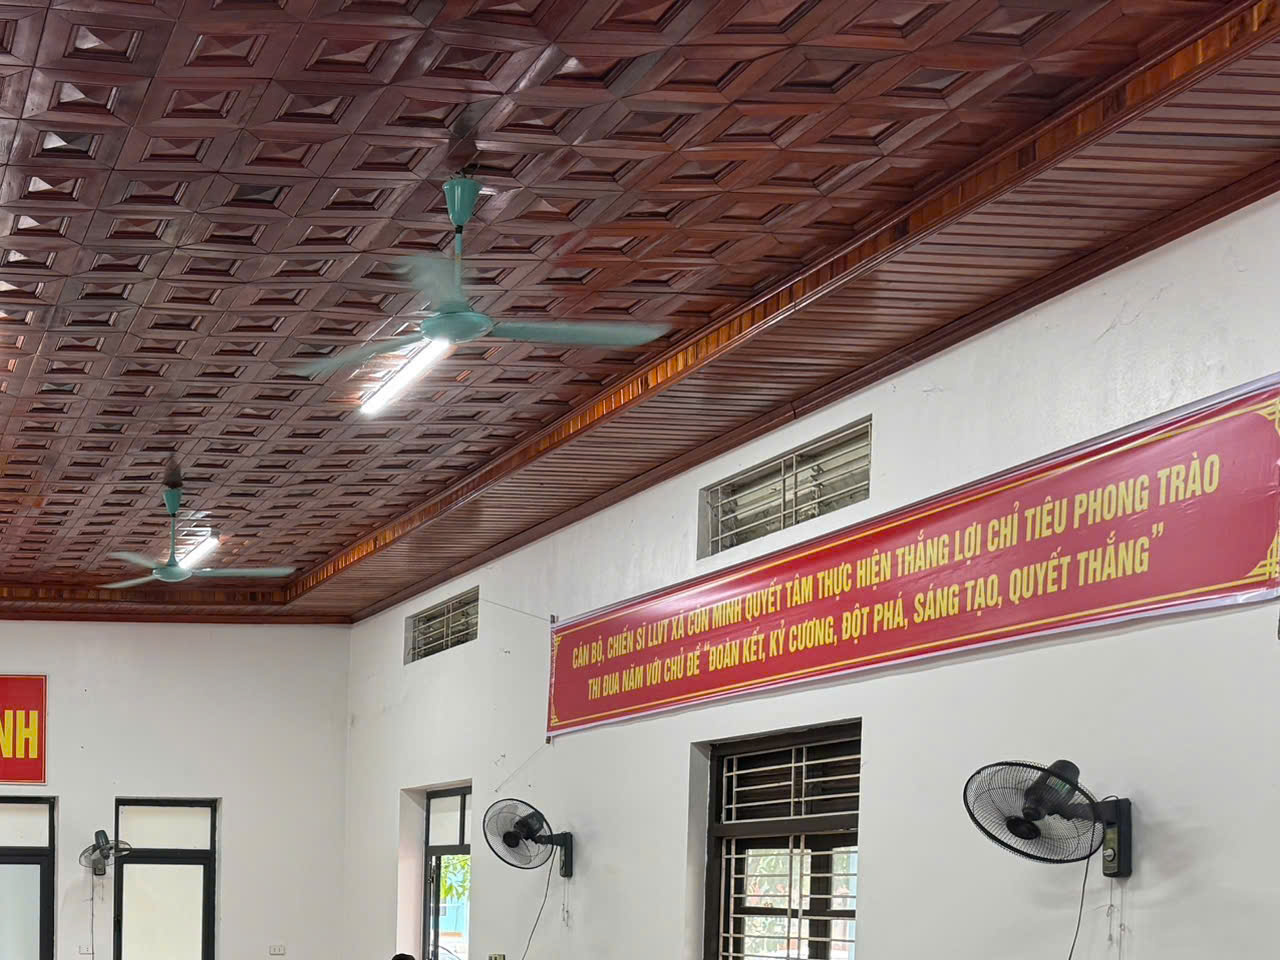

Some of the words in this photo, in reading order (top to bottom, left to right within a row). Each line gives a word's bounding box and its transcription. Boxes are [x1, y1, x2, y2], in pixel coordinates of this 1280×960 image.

[588, 676, 601, 701] THI
[602, 673, 620, 698] ĐUA
[622, 666, 643, 693] NĂM
[646, 659, 662, 688] VỚI
[663, 648, 685, 684] CHỦ
[686, 639, 702, 677] ĐỀ
[742, 626, 767, 665] KẾT,
[769, 619, 786, 658] KỶ
[788, 616, 838, 654] CƯƠNG,
[841, 602, 869, 645] ĐỘT
[873, 590, 909, 632] PHÁ,
[913, 583, 960, 625] SÁNG
[964, 573, 1002, 617] TẠO,
[1008, 547, 1072, 601] QUYẾT
[607, 625, 634, 660] CHIẾN
[636, 630, 646, 651] SĨ
[647, 621, 670, 648] LLVT
[671, 616, 685, 640] XÃ
[687, 608, 710, 637] CÔN
[712, 600, 742, 631] MINH
[745, 577, 781, 625] QUYẾT
[785, 573, 813, 607] TÂM
[816, 562, 852, 602] THỰC
[856, 549, 891, 591] HIỆN
[895, 529, 950, 573] THẮNG
[954, 522, 982, 566] LỢI
[987, 500, 1019, 554] CHỈ
[1024, 495, 1068, 543] TIÊU
[1073, 473, 1150, 529] PHONG
[1157, 451, 1220, 506] TRÀO
